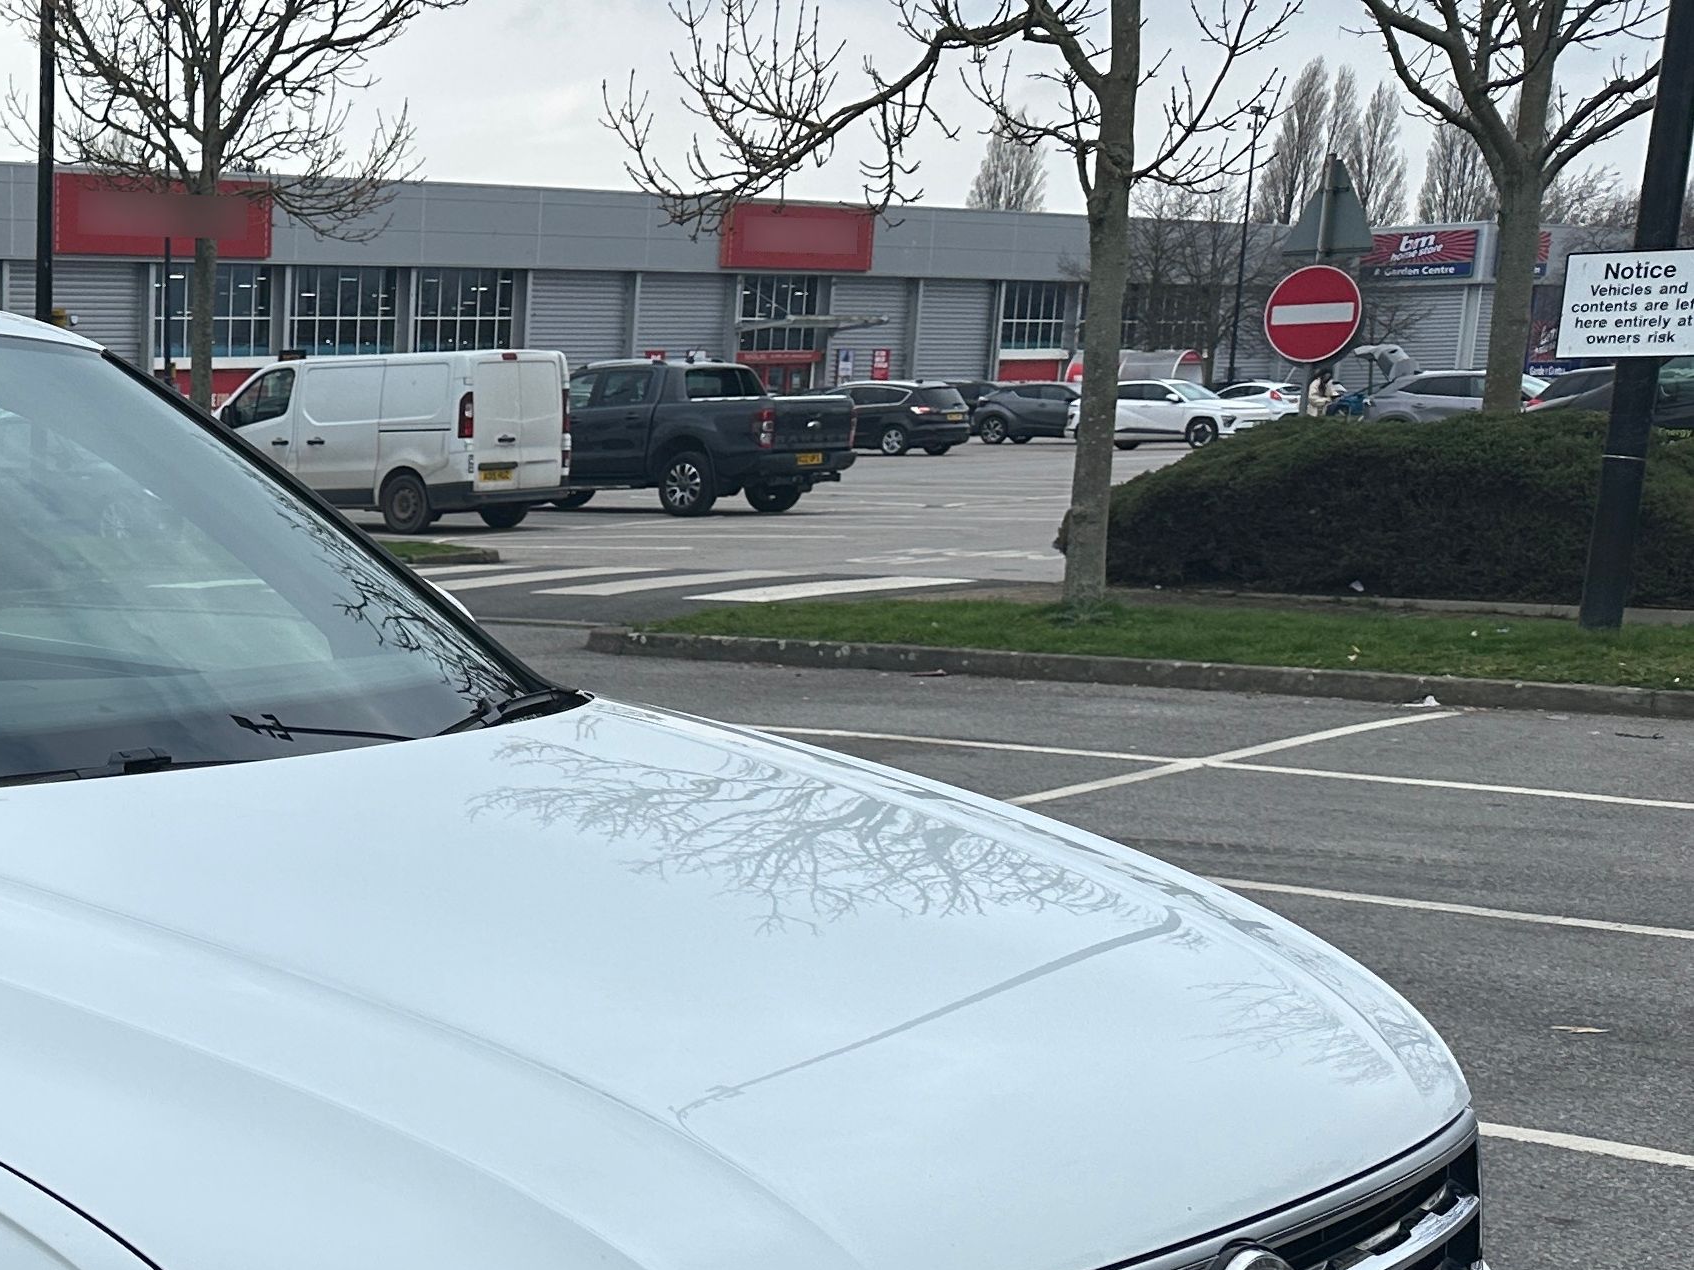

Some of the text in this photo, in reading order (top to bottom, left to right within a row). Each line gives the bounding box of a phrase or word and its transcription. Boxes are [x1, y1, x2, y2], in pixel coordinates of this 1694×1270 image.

[1421, 265, 1455, 275] Centre
[1604, 260, 1677, 280] Notice
[1590, 282, 1688, 297] Vehicles and
[1571, 300, 1638, 313] contents
[1644, 301, 1669, 312] are
[1574, 315, 1694, 330] here entirely at
[1586, 331, 1676, 345] owners risk
